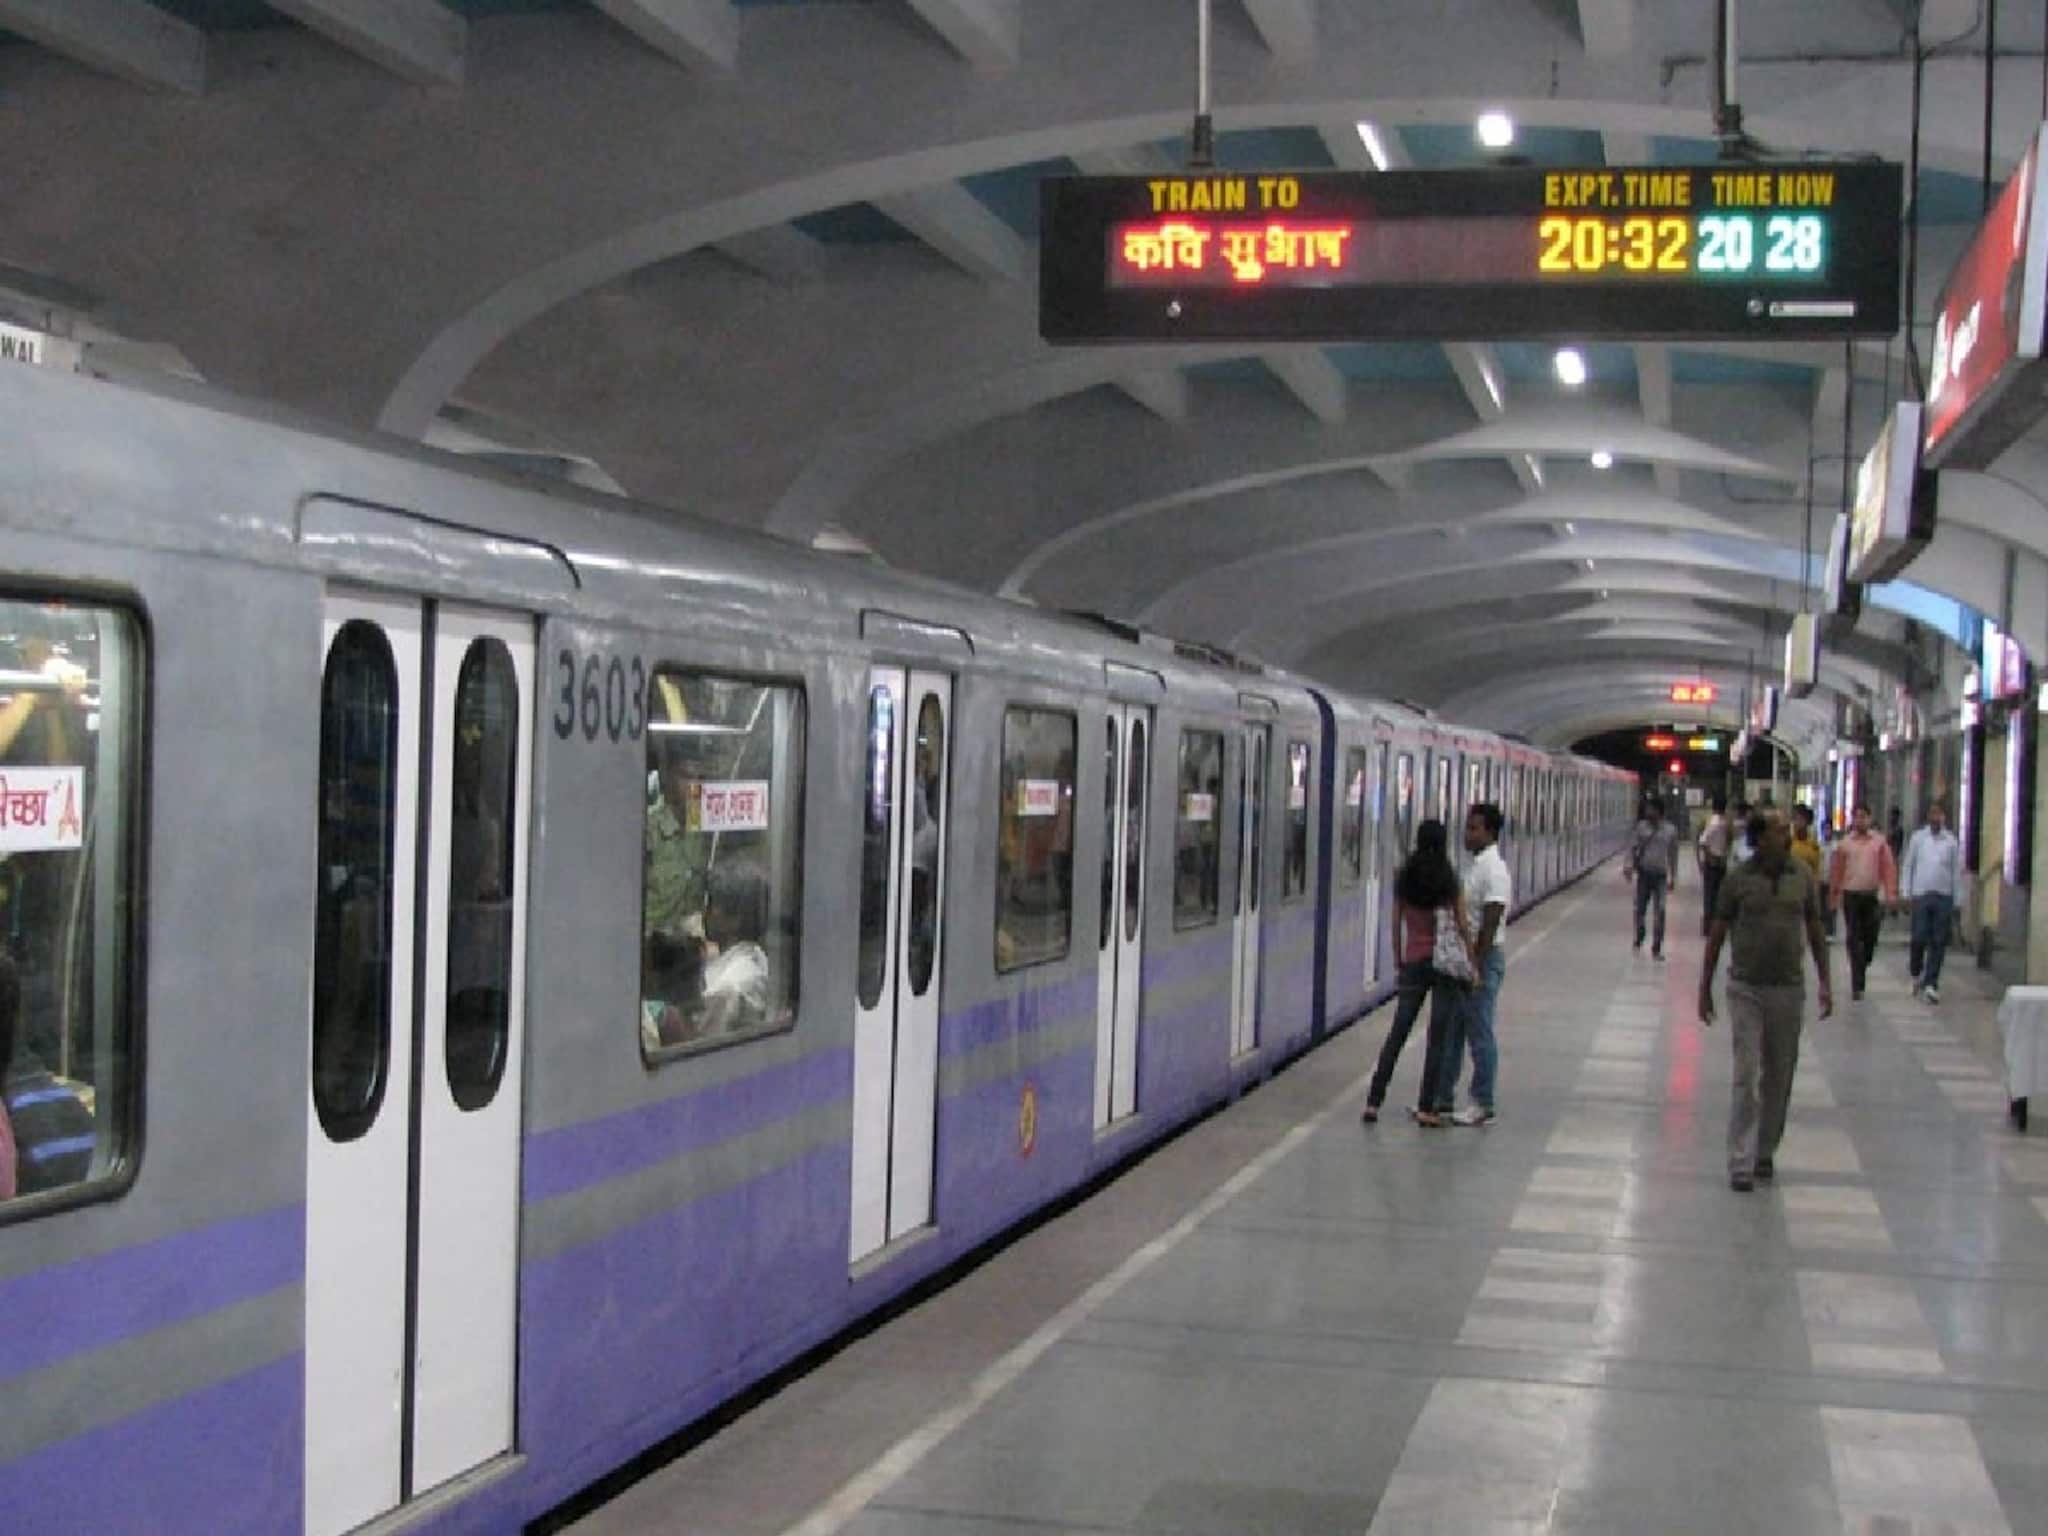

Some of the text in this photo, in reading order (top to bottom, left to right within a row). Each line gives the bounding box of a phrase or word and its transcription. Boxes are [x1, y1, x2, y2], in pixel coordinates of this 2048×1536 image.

[1149, 176, 1299, 211] TRAIN TO
[1623, 174, 1691, 206] TIME
[1712, 174, 1833, 206] TIME NOW
[1123, 223, 1210, 270] कवि
[1538, 217, 1688, 271] 20:32
[1697, 215, 1822, 272] 20 28
[554, 648, 645, 744] 3603
